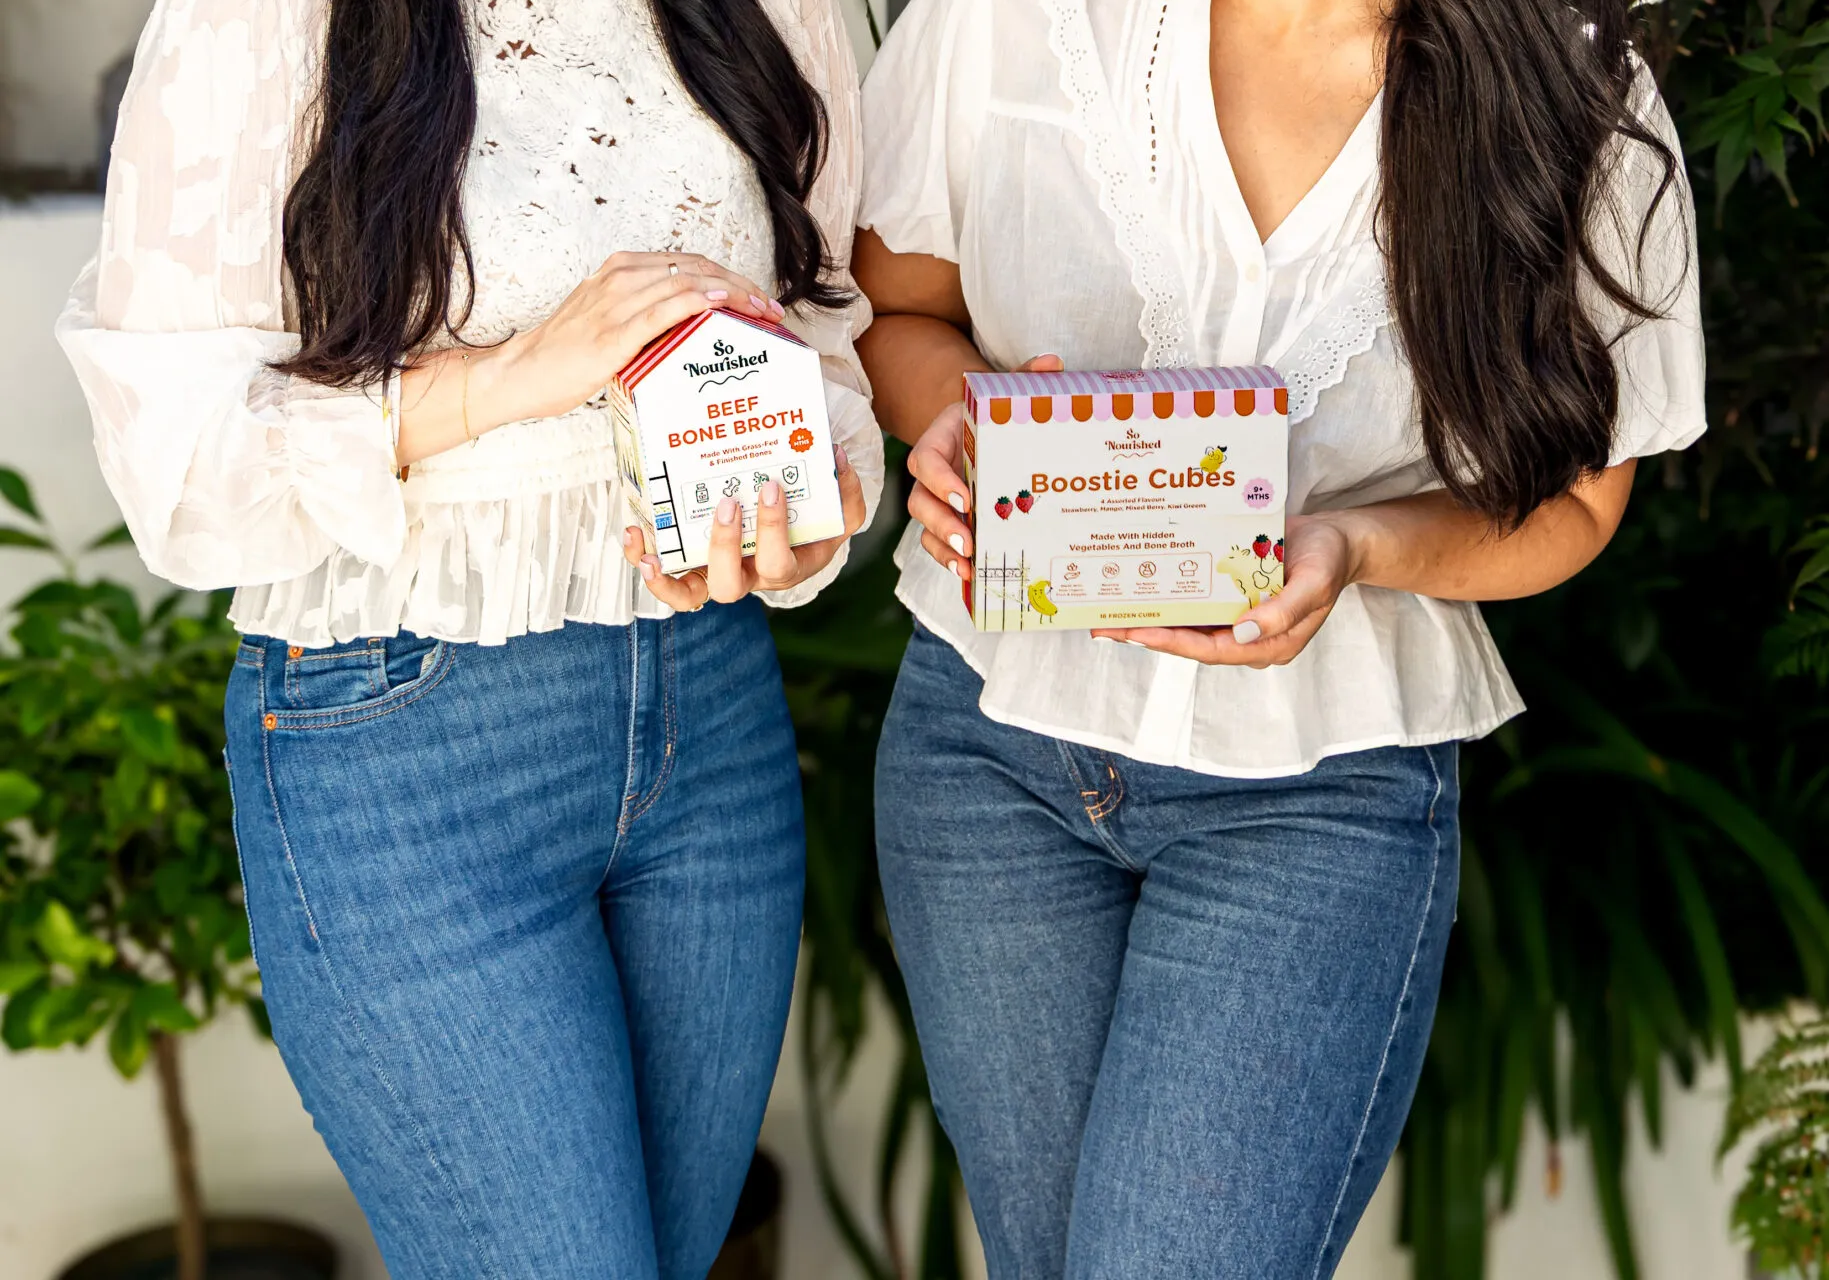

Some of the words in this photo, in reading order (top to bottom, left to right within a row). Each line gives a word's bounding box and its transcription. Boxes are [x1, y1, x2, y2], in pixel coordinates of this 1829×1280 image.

[713, 339, 734, 357] So
[683, 350, 768, 377] Nourished
[707, 396, 758, 419] BEEF
[668, 424, 727, 448] BONE
[733, 408, 804, 435] BROTH
[1126, 428, 1140, 440] So
[700, 451, 720, 460] Made
[722, 447, 740, 455] With
[742, 439, 779, 451] Grass-Fed
[1105, 440, 1161, 451] Nourished
[717, 453, 748, 465] Finished
[749, 449, 772, 459] Bones
[1031, 469, 1138, 493] Boostie
[1148, 466, 1236, 489] Cubes
[1090, 532, 1115, 541] Made
[1118, 532, 1139, 540] With
[1142, 531, 1175, 539] Hidden
[1069, 542, 1120, 552] Vegetables
[1123, 542, 1142, 550] And
[1170, 540, 1195, 548] Broth
